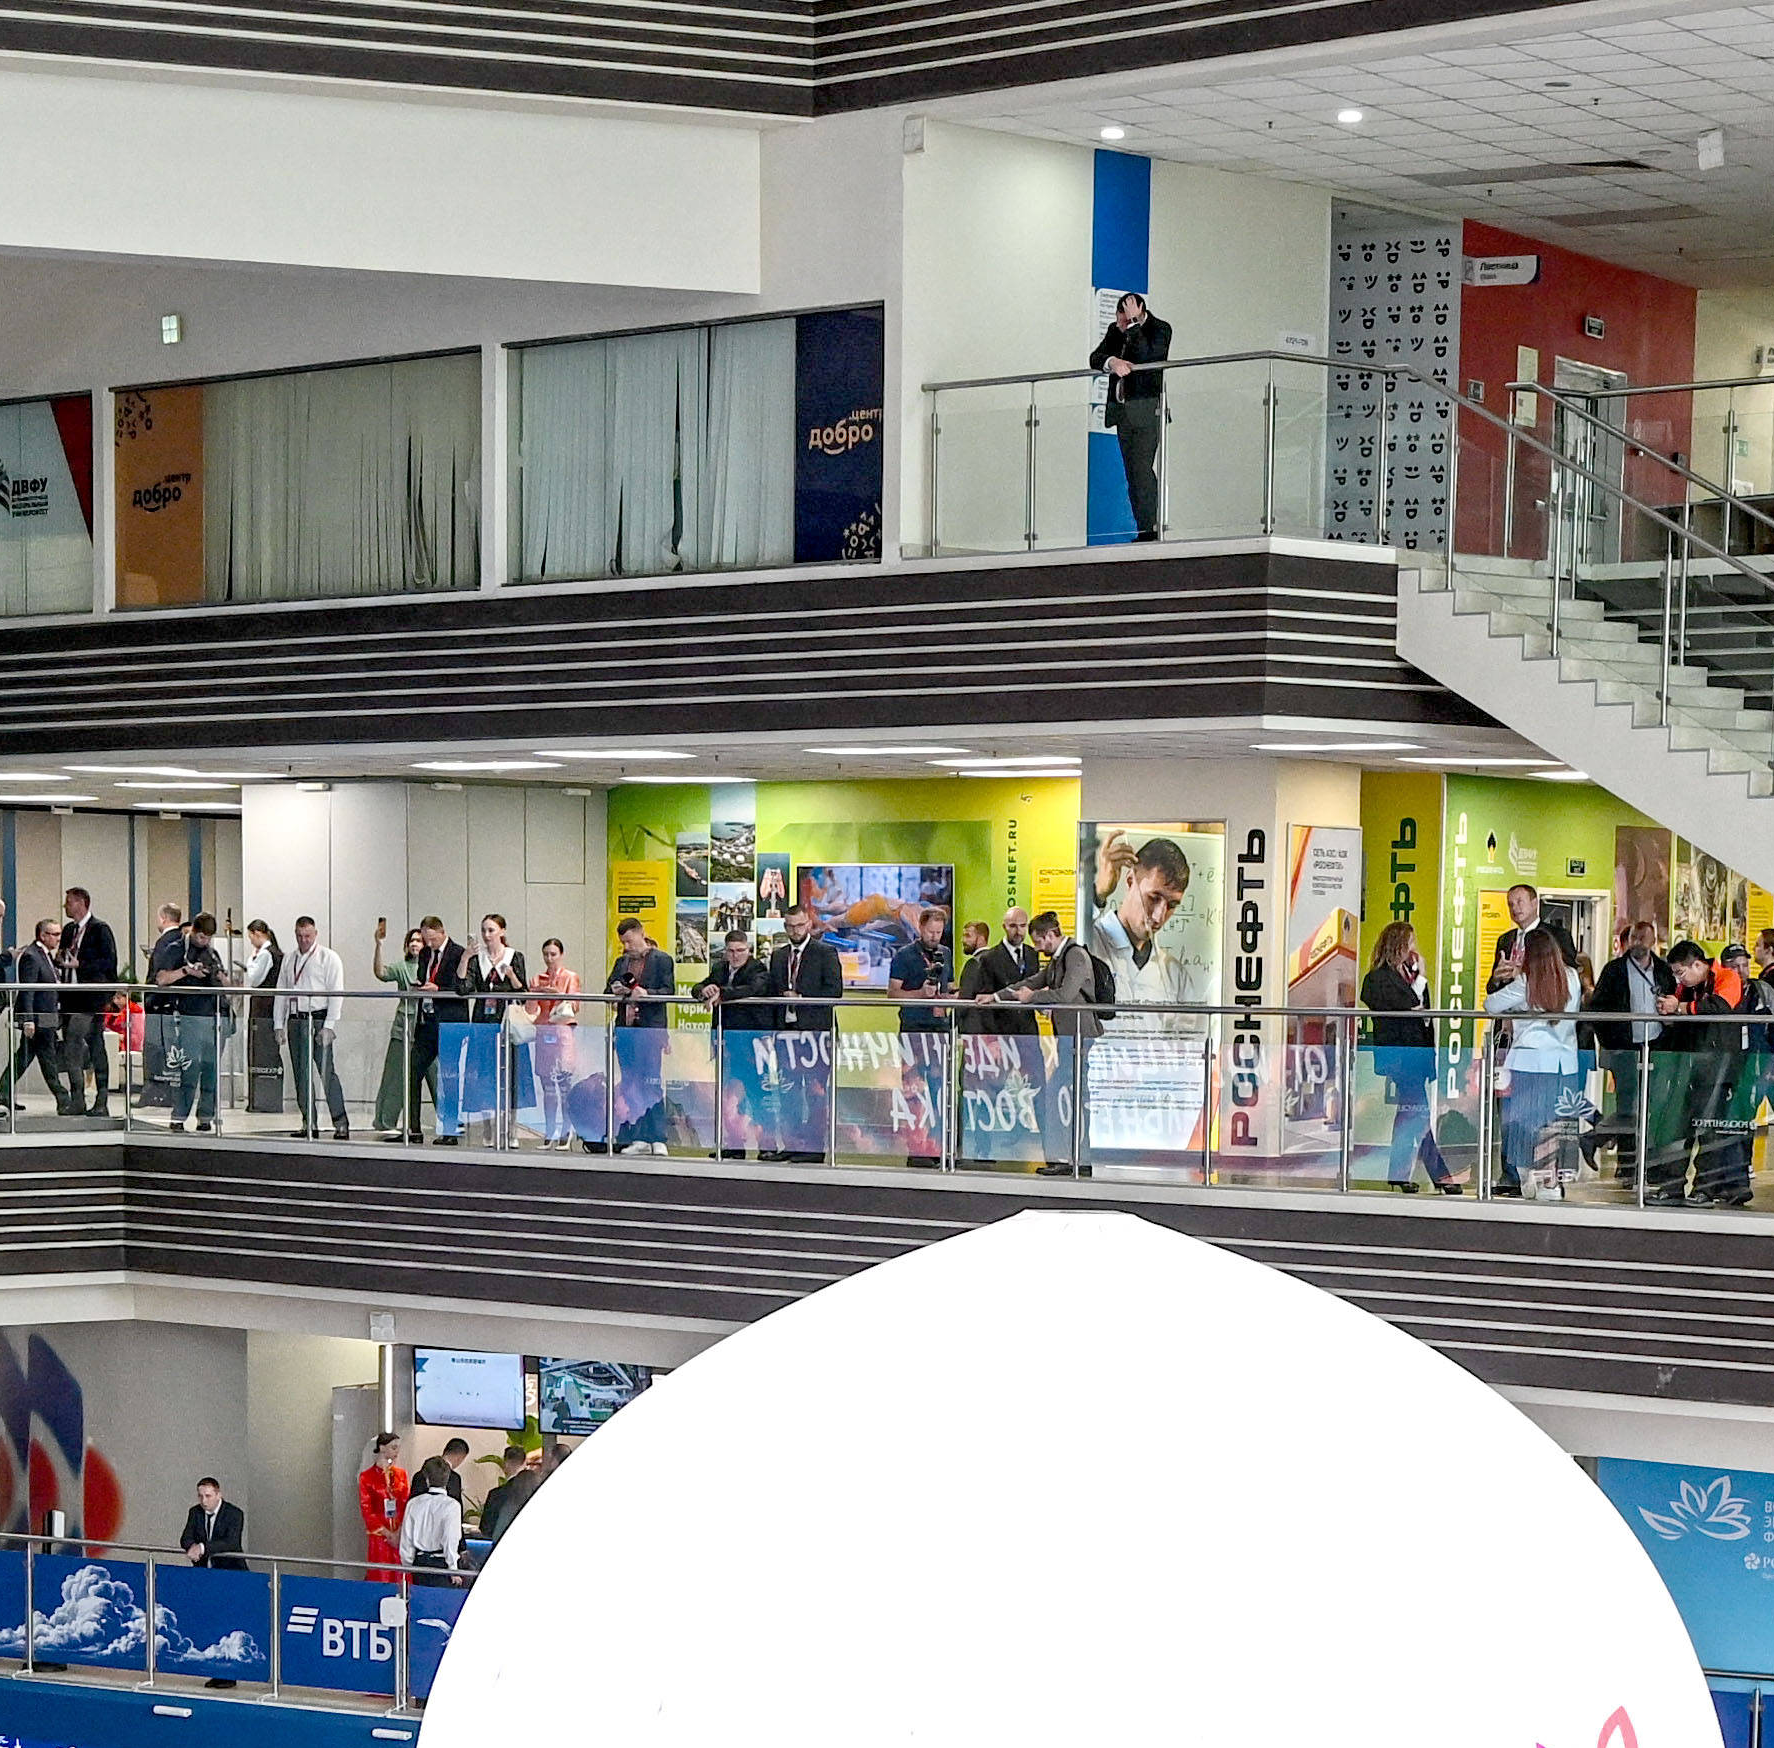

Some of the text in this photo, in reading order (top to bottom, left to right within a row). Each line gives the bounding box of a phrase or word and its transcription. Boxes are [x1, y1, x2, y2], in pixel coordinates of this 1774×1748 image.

[809, 418, 874, 450] добро
[12, 478, 48, 497] ДВФУ
[131, 483, 182, 509] добро
[1007, 818, 1018, 908] OSNEFT.RU
[1446, 811, 1470, 1100] РОСНЕФТЬ
[1230, 827, 1266, 1147] РОСНЕФТЬ
[323, 1618, 393, 1662] ВТБ
